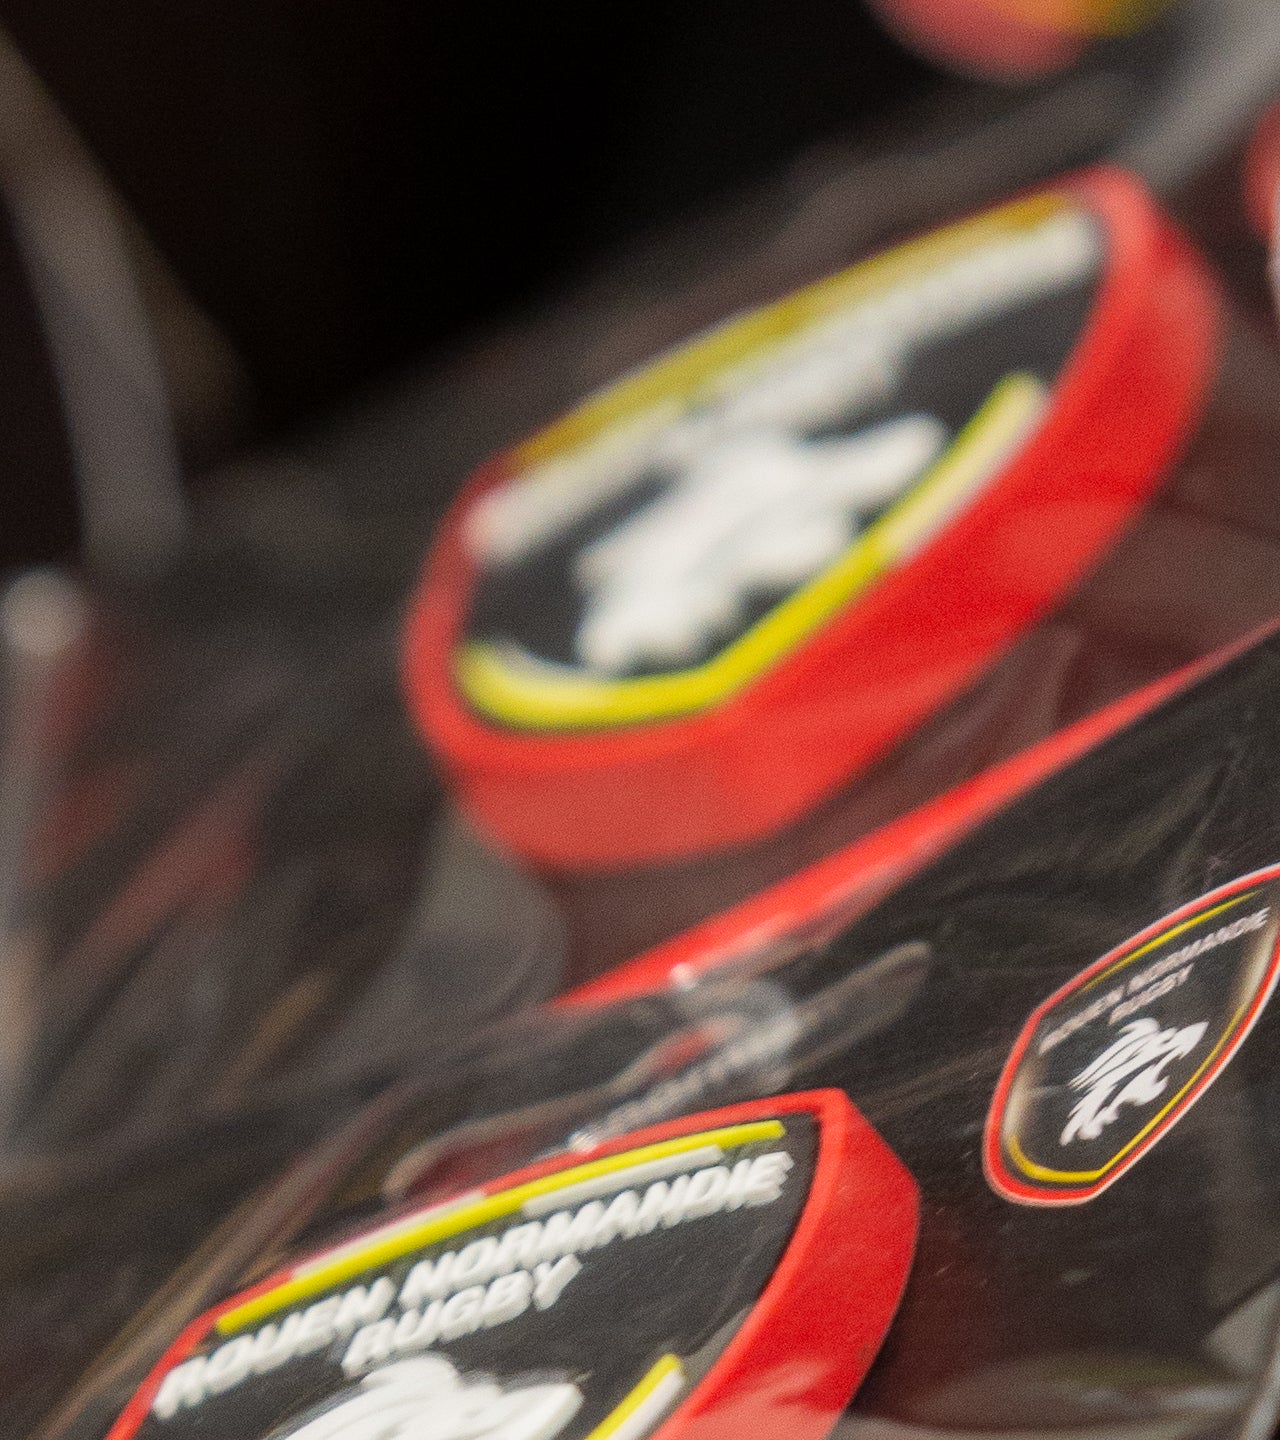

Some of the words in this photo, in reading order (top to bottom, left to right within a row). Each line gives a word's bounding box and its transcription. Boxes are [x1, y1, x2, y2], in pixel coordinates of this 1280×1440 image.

[153, 1276, 397, 1420] ROUEN
[398, 1151, 794, 1311] NORMANDIE
[342, 1255, 583, 1377] RUGBY
